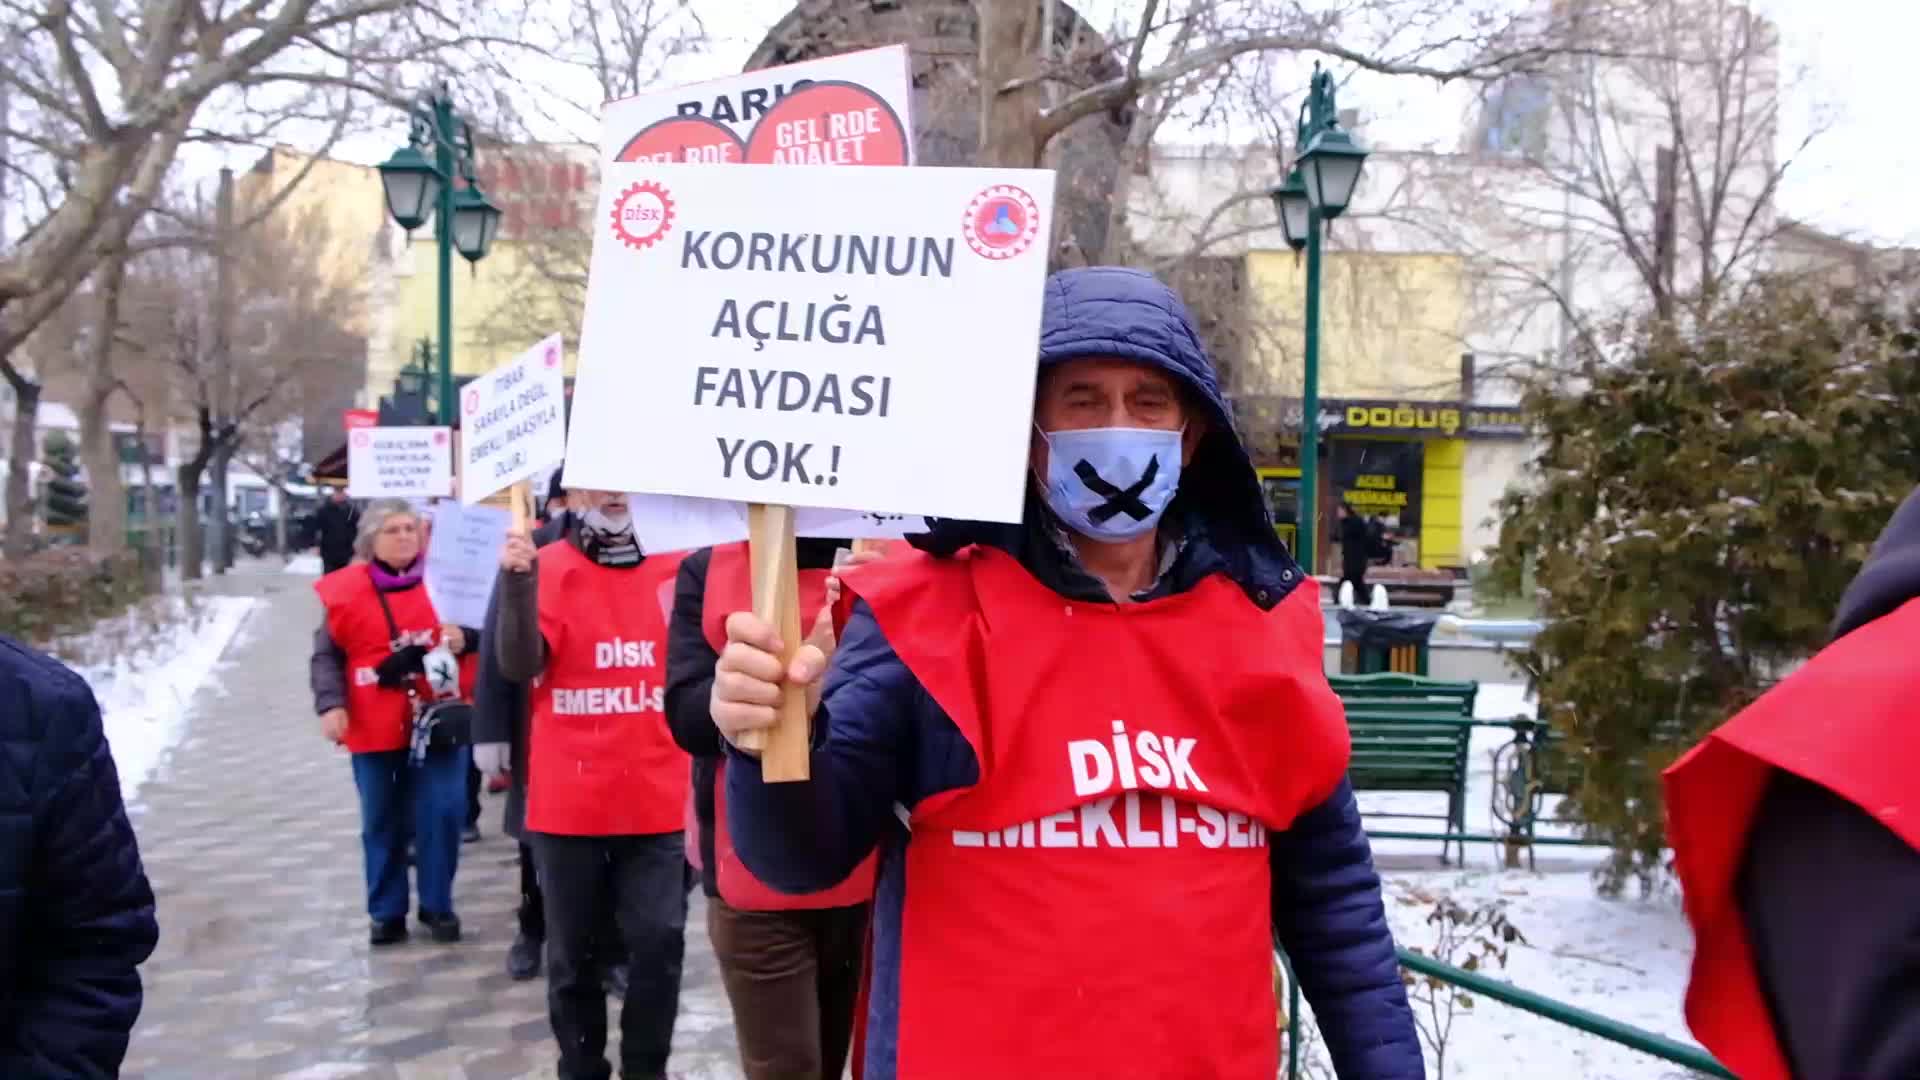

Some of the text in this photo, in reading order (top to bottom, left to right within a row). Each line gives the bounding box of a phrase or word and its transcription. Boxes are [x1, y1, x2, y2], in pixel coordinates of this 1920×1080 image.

[677, 79, 815, 123] BARI
[680, 231, 955, 277] KORKUNUN
[711, 294, 887, 350] AÇLIĞA
[693, 366, 892, 417] FAYDASI
[1346, 402, 1461, 436] DOĞUŞ
[716, 437, 842, 486] YOK.!
[595, 636, 656, 669] DİSK
[1068, 719, 1209, 797] DİSK
